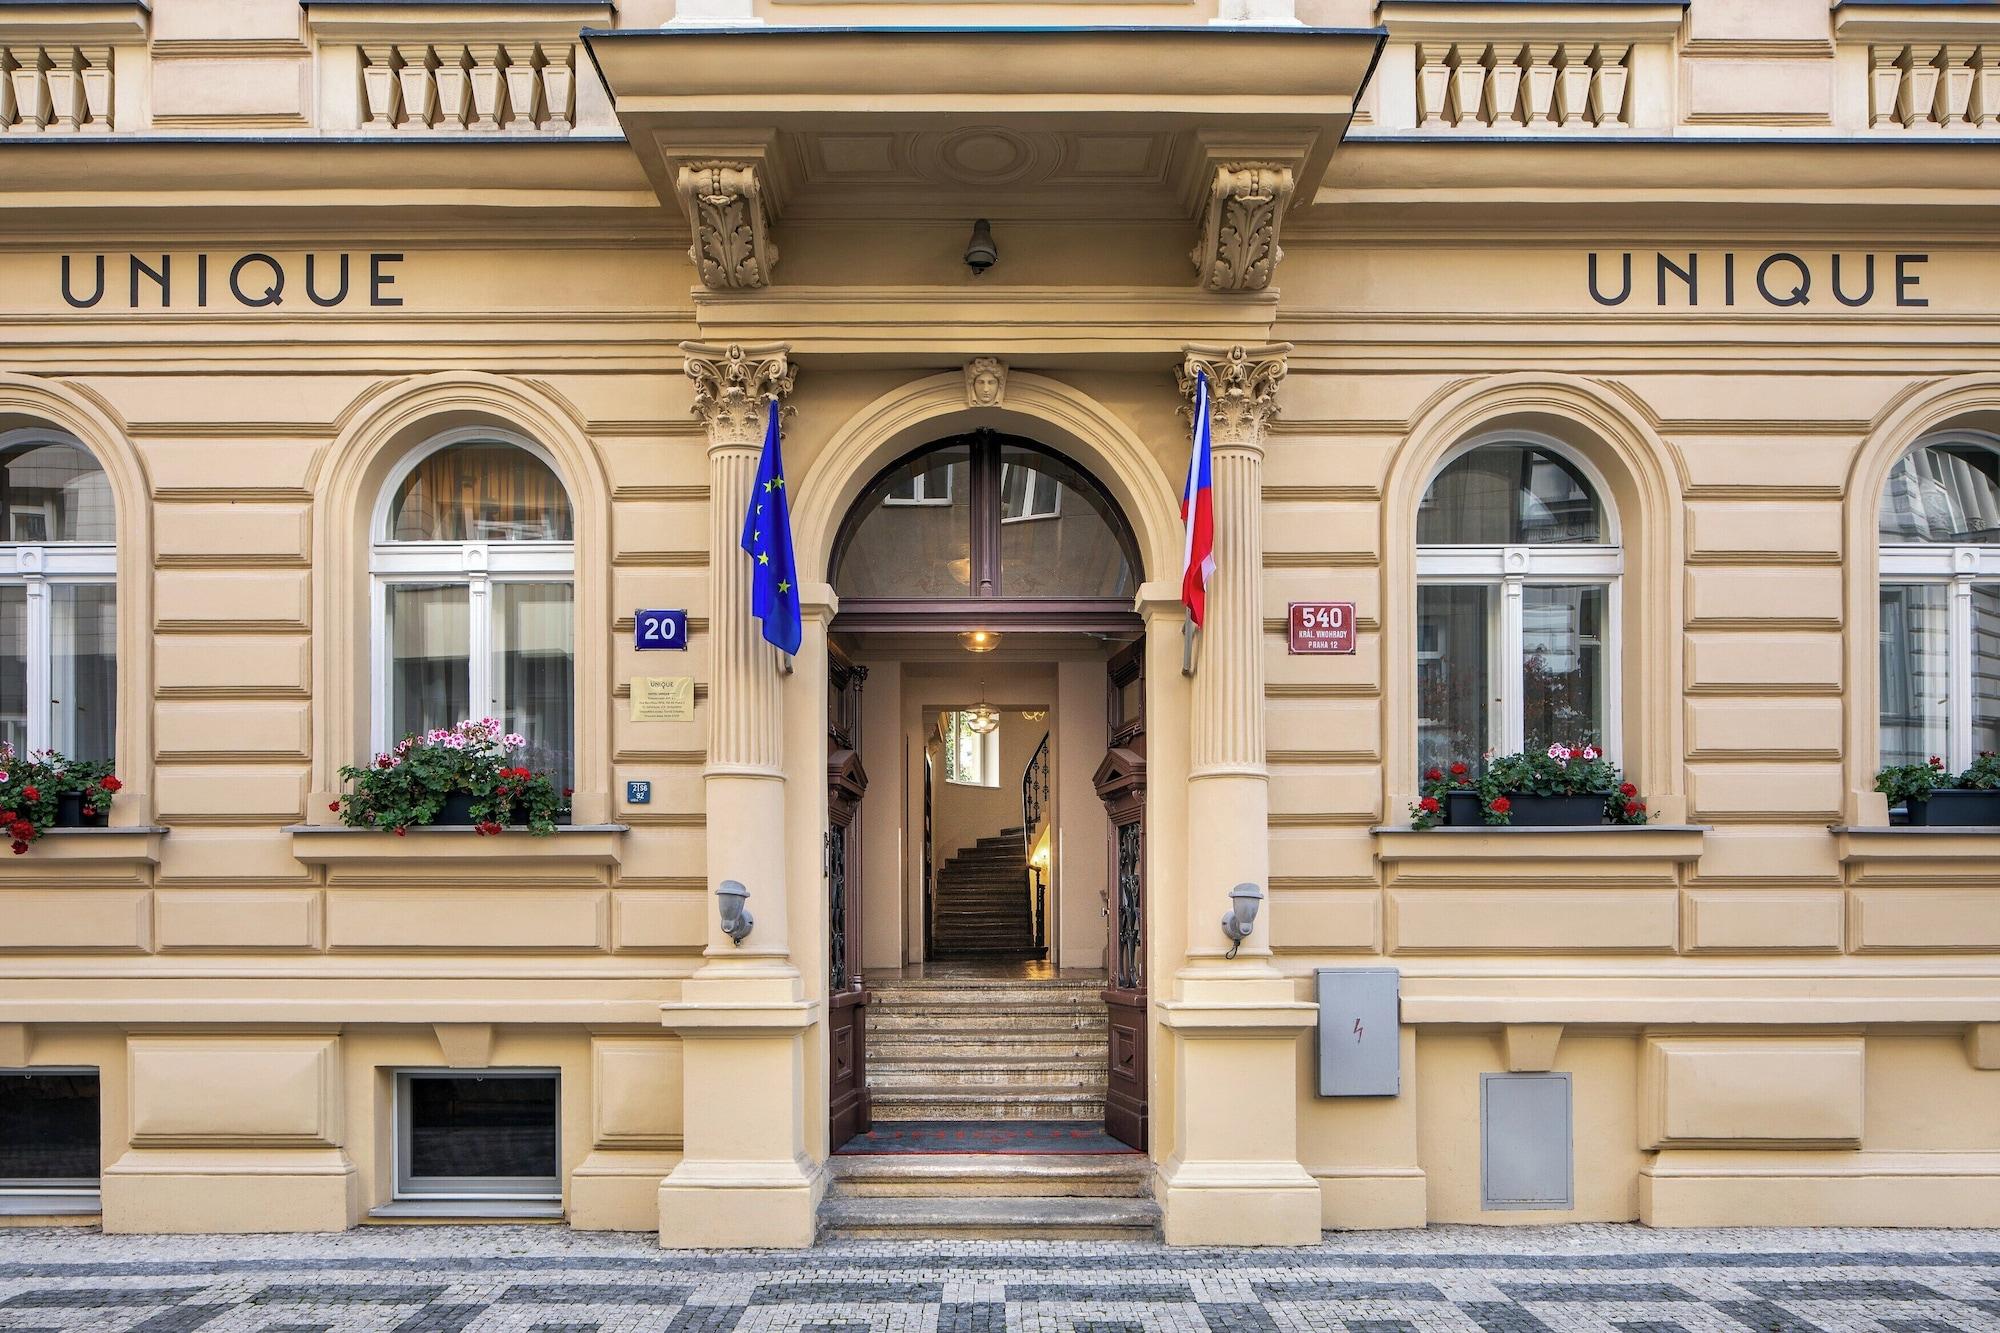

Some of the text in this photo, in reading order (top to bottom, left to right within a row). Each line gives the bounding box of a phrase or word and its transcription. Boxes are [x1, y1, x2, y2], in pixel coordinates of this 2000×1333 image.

[61, 253, 404, 308] UNIQUE
[1588, 252, 1929, 307] UNIQUE
[1302, 607, 1342, 628] 540
[644, 617, 676, 640] 20
[1316, 630, 1347, 638] VINOHRADY
[1308, 641, 1338, 649] PRAHA 12
[650, 681, 674, 689] UNIQUE
